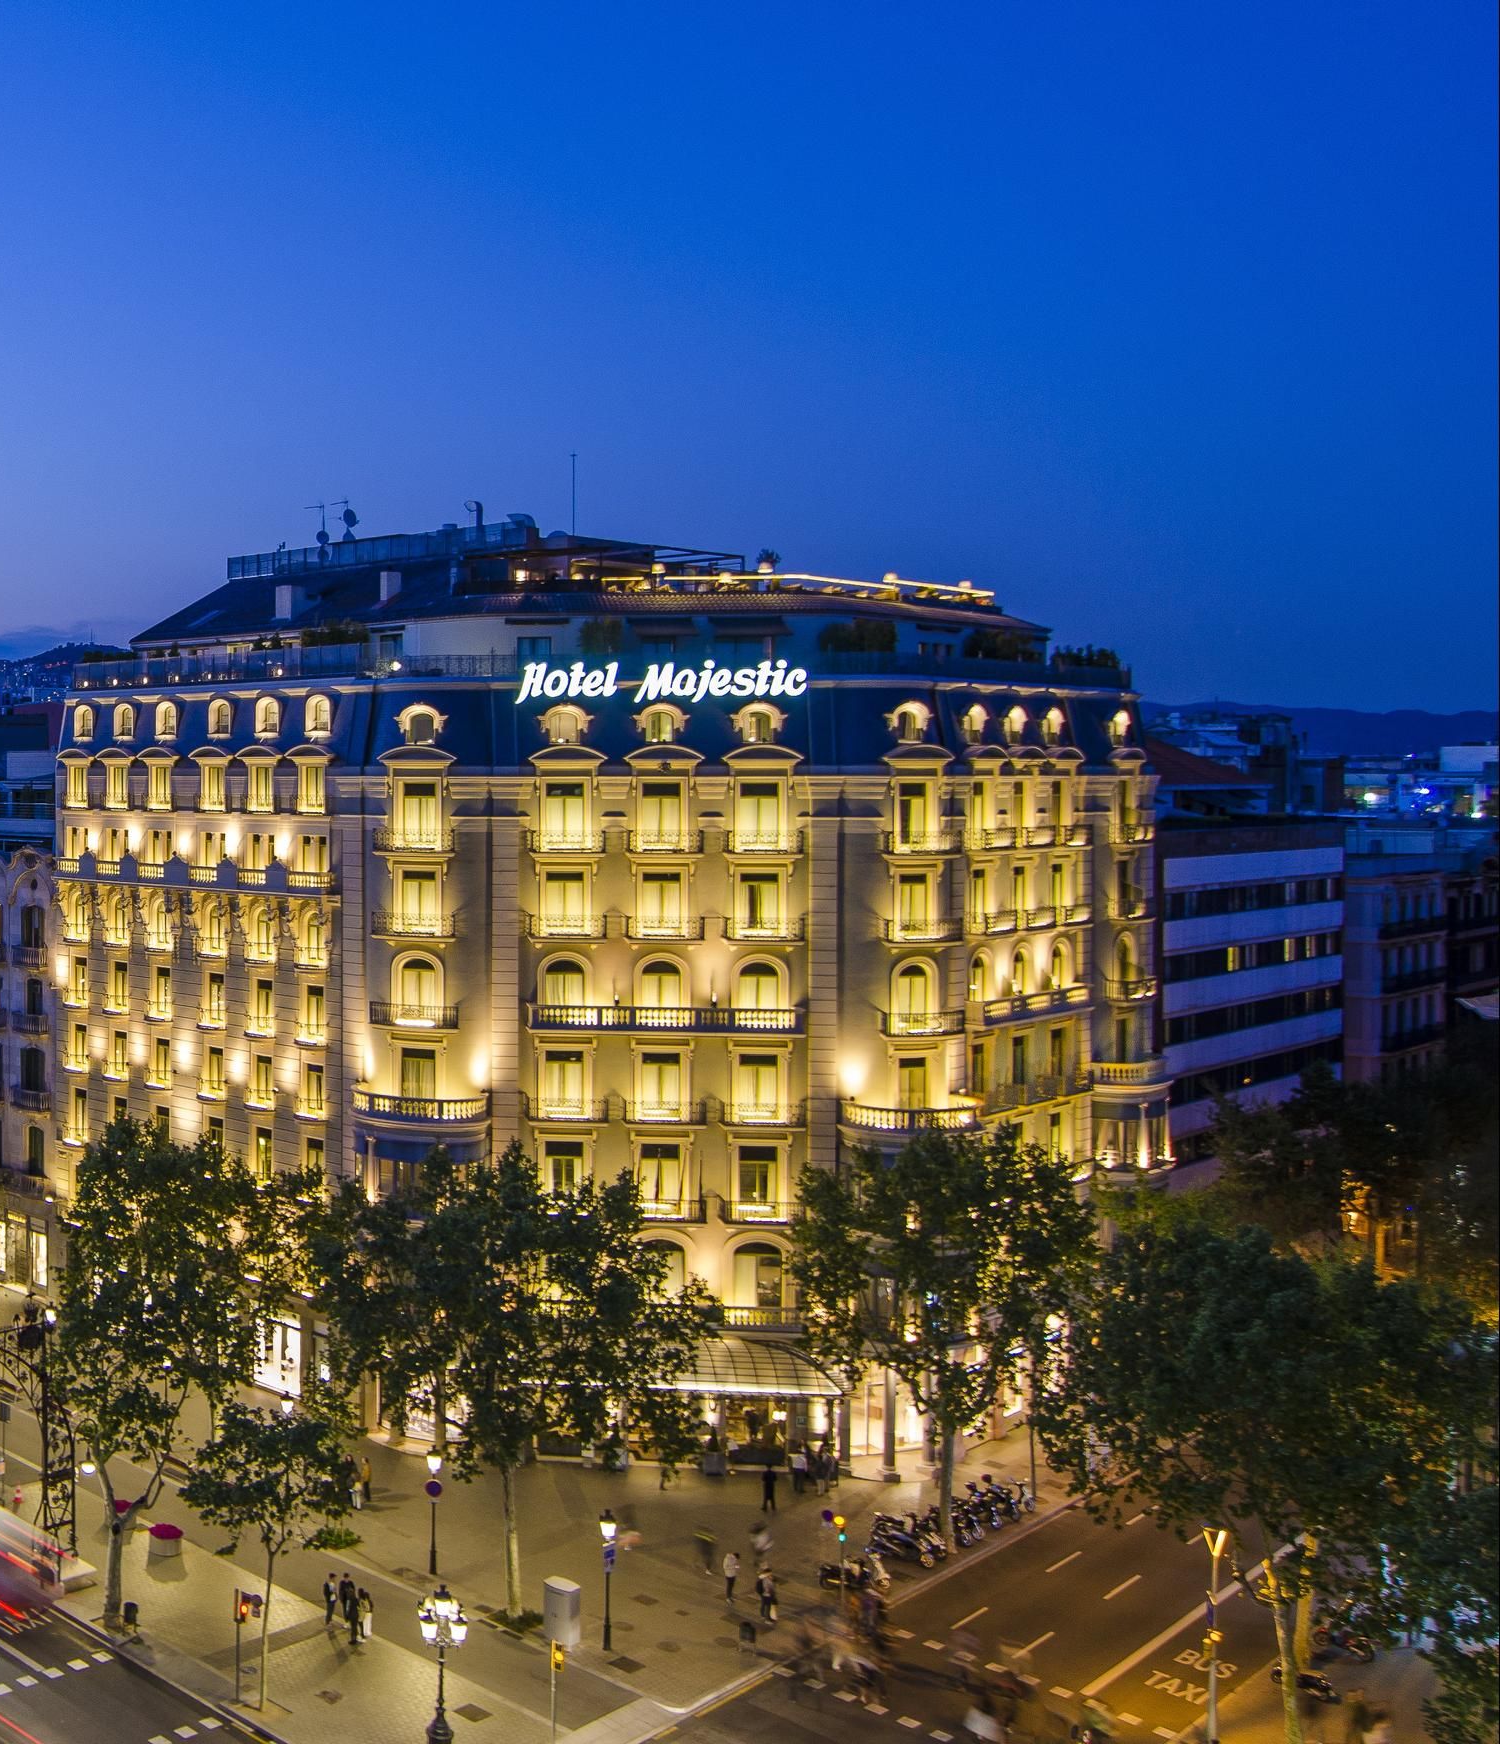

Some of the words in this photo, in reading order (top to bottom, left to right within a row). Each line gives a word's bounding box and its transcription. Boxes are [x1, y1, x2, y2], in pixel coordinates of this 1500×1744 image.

[515, 661, 619, 704] Hotel
[633, 659, 808, 703] Majestic
[1172, 1649, 1239, 1679] BUS
[1143, 1670, 1211, 1705] TAXI
